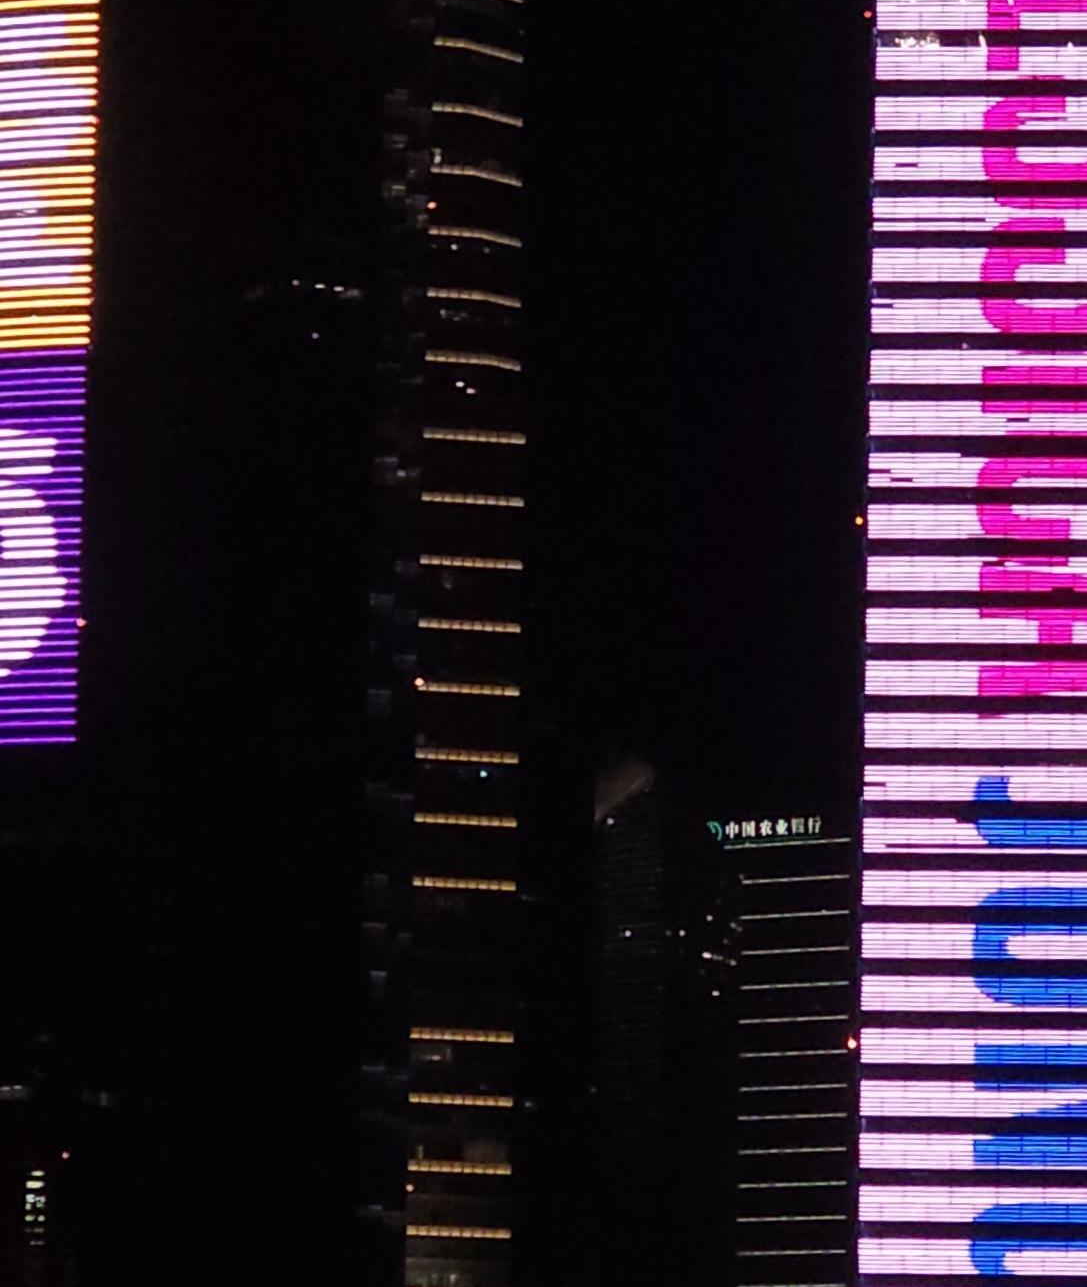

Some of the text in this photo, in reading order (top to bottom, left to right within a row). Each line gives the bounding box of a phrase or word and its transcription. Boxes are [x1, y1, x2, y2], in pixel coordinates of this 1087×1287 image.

[724, 815, 823, 840] 中国农业银行
